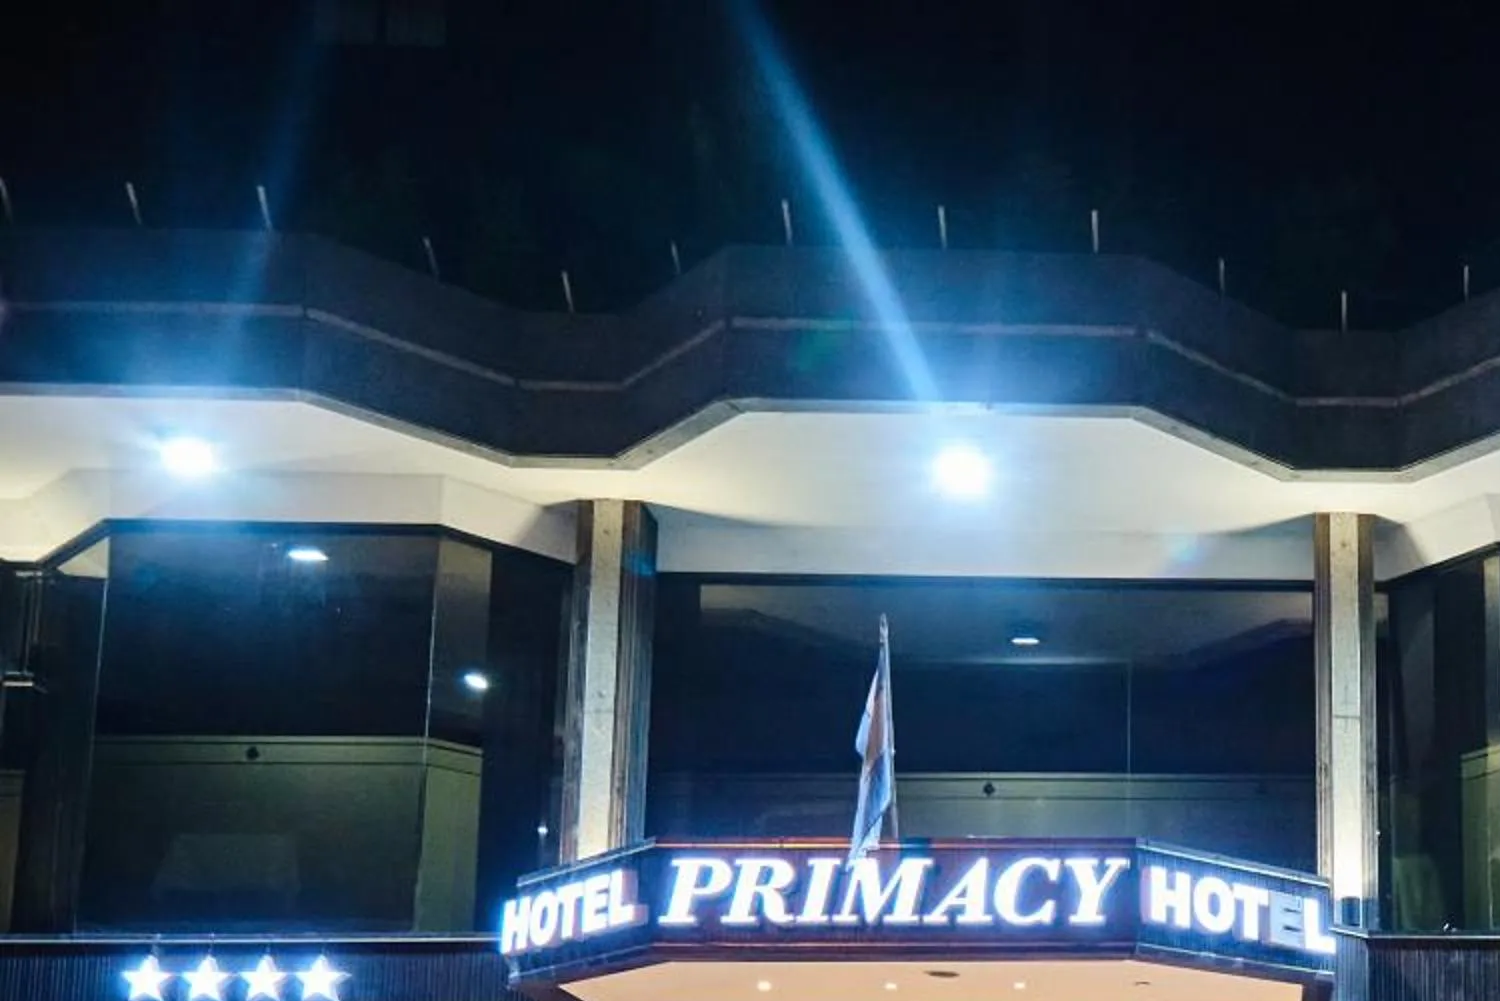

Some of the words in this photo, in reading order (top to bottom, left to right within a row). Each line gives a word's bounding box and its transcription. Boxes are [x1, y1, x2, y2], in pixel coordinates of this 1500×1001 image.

[500, 868, 637, 955] HOTEL
[657, 857, 1131, 926] PRIMACY
[1149, 865, 1337, 955] HOTEL
